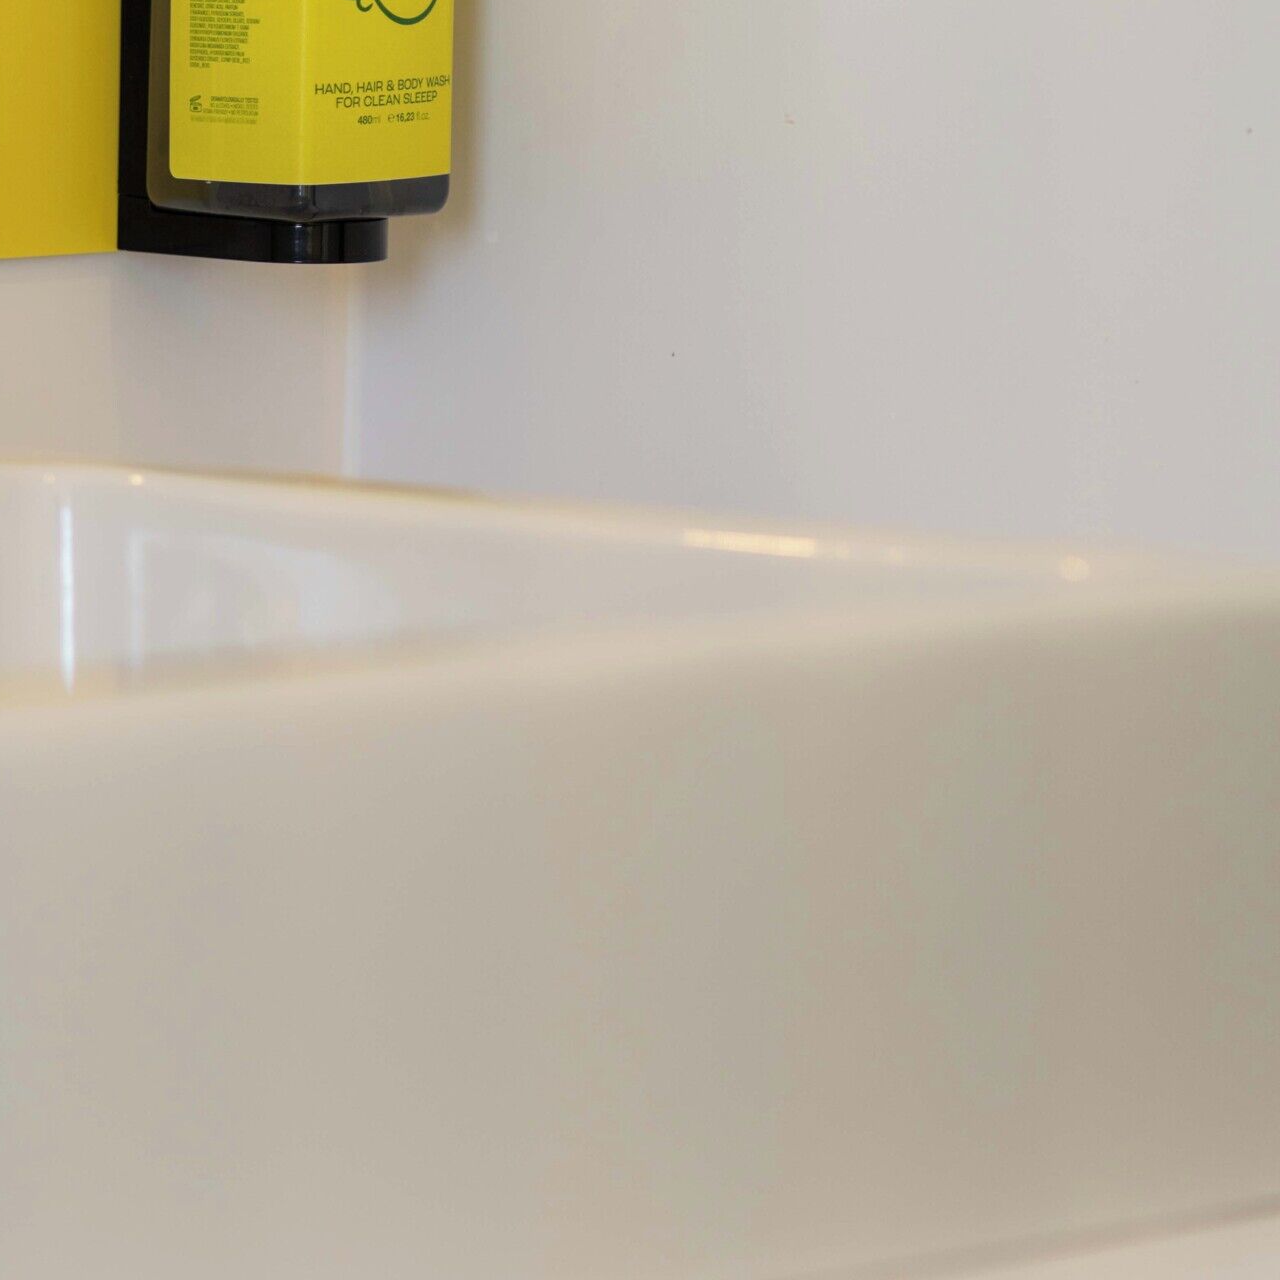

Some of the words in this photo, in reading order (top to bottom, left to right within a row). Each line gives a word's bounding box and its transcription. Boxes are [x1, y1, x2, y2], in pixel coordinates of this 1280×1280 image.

[314, 82, 354, 95] HAND,
[356, 80, 383, 93] HAIR
[386, 80, 395, 91] &
[397, 78, 423, 91] BODY
[426, 75, 451, 87] WASH
[336, 96, 361, 108] FOR
[363, 94, 400, 107] CLEAN
[403, 90, 438, 104] SLEEEP
